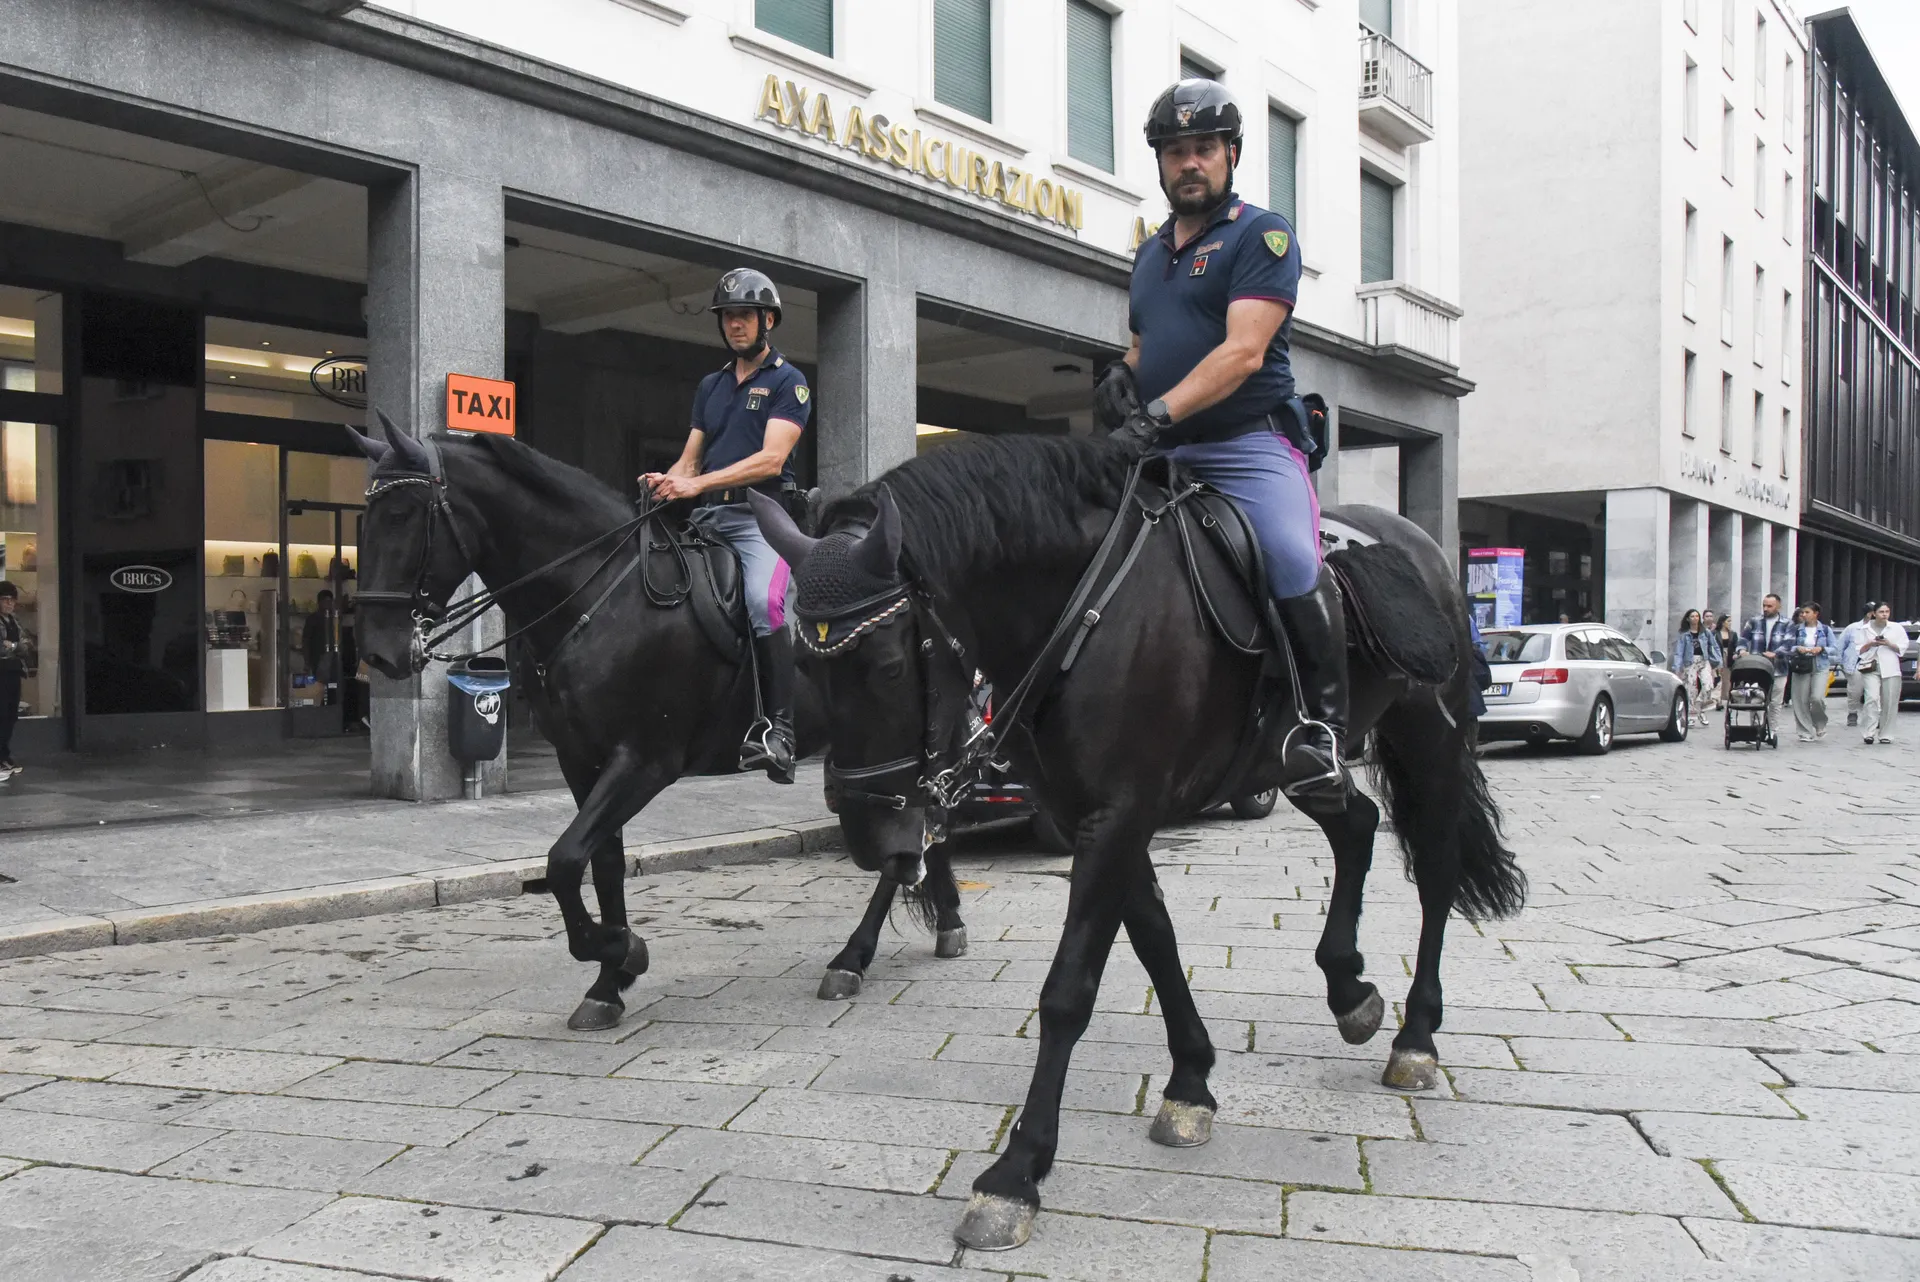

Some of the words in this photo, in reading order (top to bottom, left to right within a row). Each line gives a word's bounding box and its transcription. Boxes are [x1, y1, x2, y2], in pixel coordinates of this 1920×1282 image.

[757, 73, 837, 143] AXA
[842, 105, 1084, 231] ASSICURAZIONI
[451, 389, 513, 422] TAXI
[122, 572, 162, 586] BRIC'S
